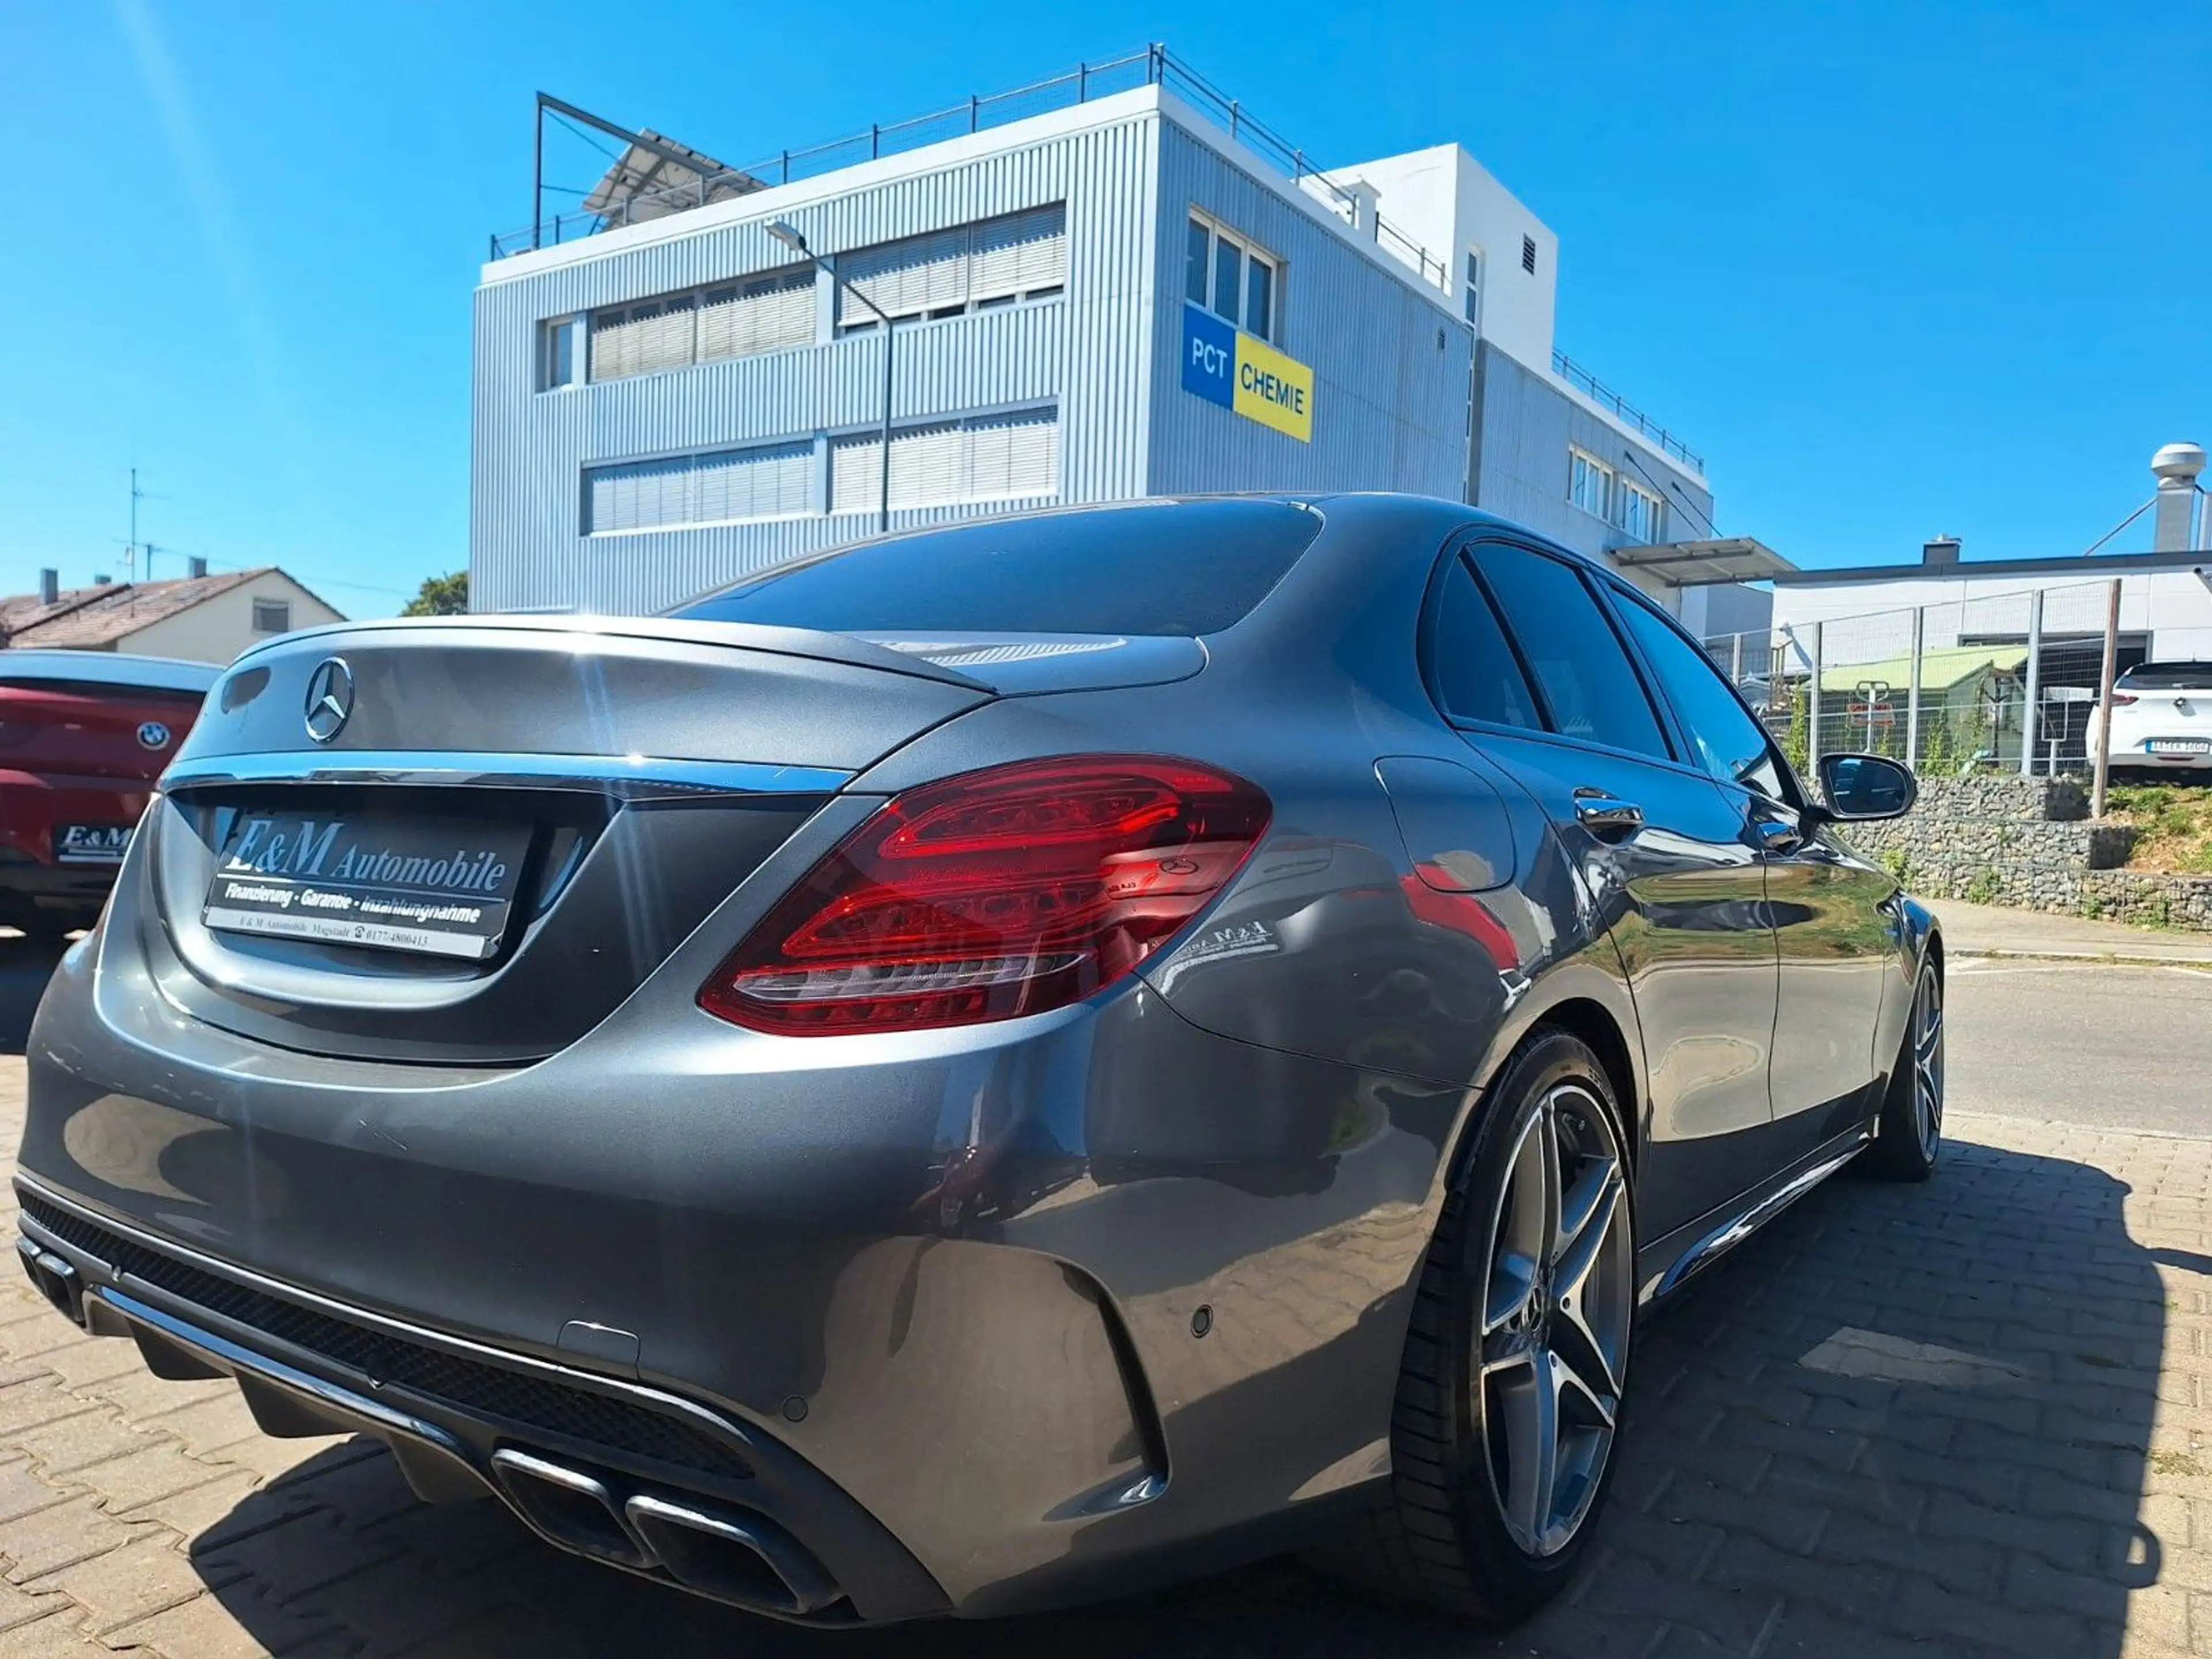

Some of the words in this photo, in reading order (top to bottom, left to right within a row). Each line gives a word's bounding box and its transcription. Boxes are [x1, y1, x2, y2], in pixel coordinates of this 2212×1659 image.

[1192, 336, 1228, 379] PCT
[1241, 362, 1304, 415] CHEMIE
[62, 825, 134, 847] E&M
[225, 819, 344, 876] E&M
[331, 843, 506, 891] Automobile
[225, 882, 294, 909] Finanzierung
[301, 889, 353, 910] Garantie
[359, 895, 482, 923] Inzahlungnahme
